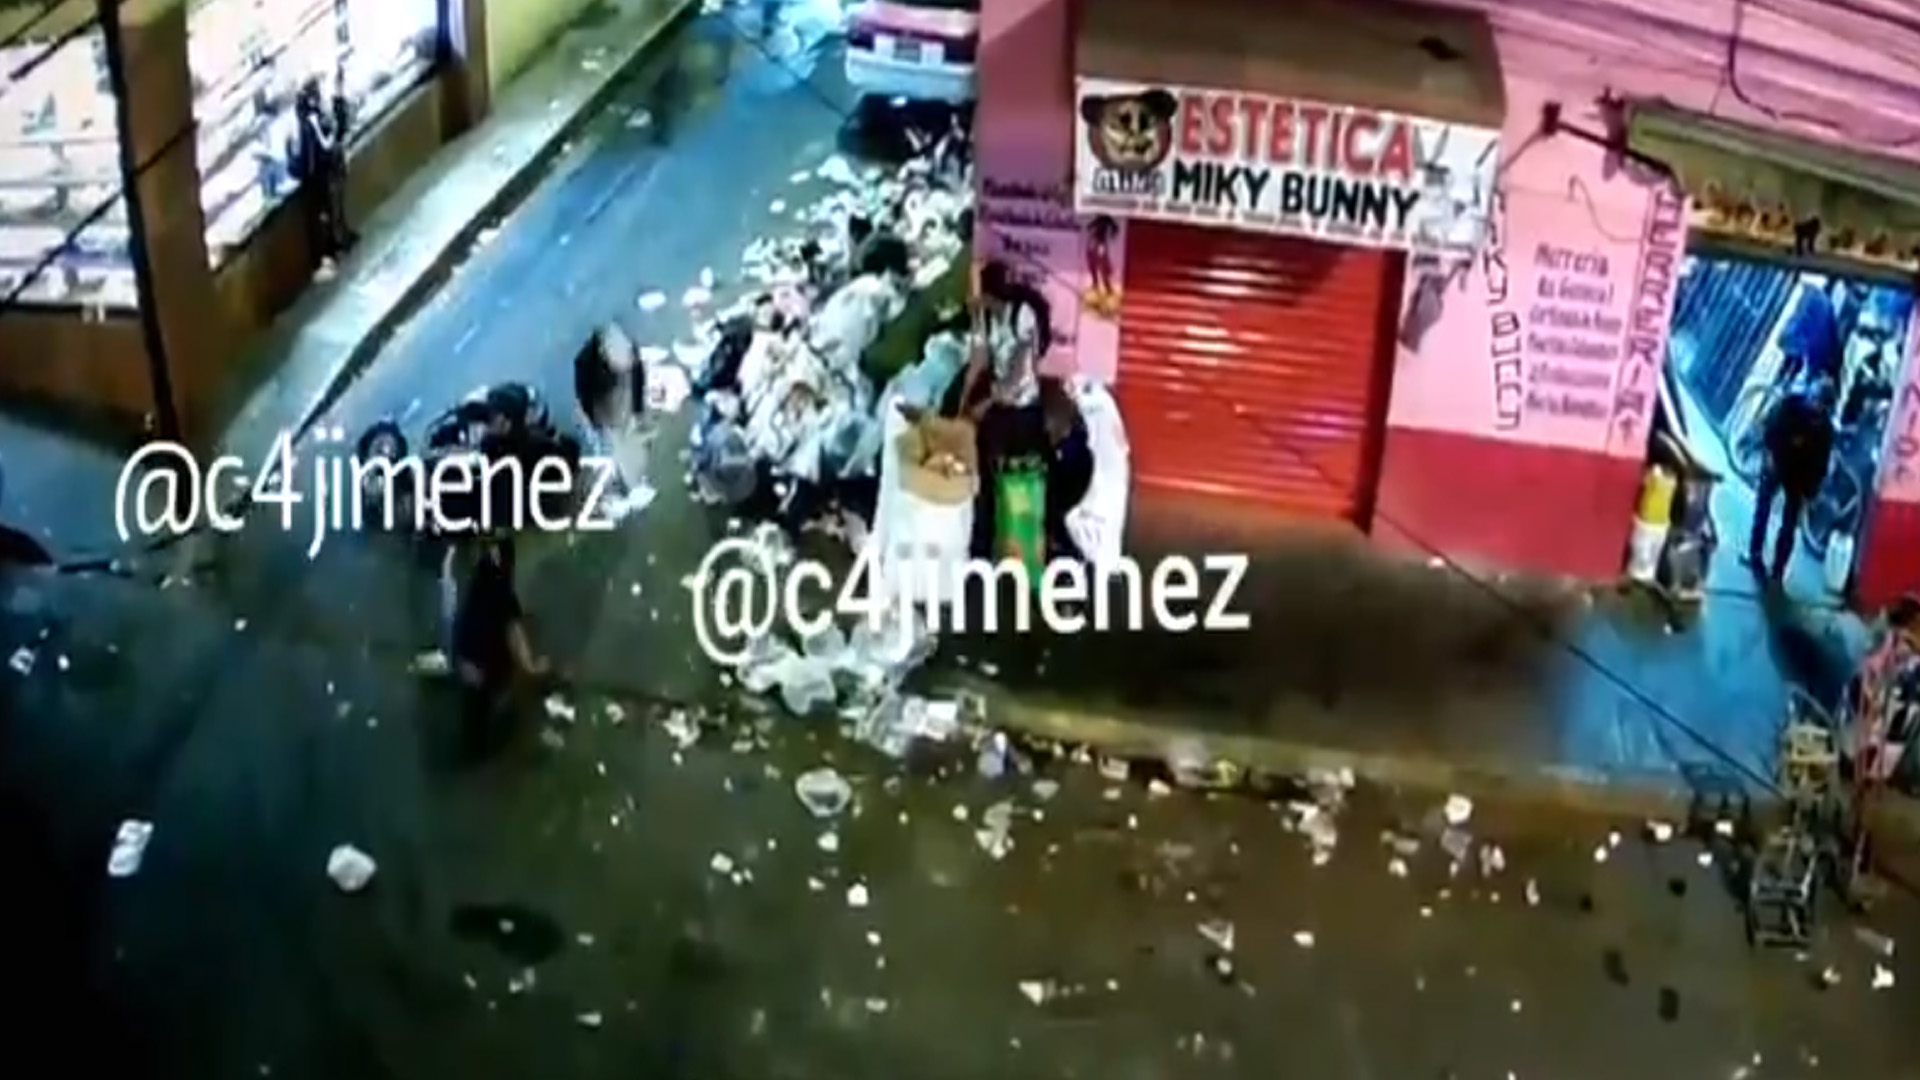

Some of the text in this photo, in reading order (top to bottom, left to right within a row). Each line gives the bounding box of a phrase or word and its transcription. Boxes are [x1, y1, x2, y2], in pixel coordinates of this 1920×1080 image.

[1177, 94, 1416, 180] ESTETICA
[1172, 160, 1270, 212] MIKY
[1281, 171, 1420, 230] BUNNY
